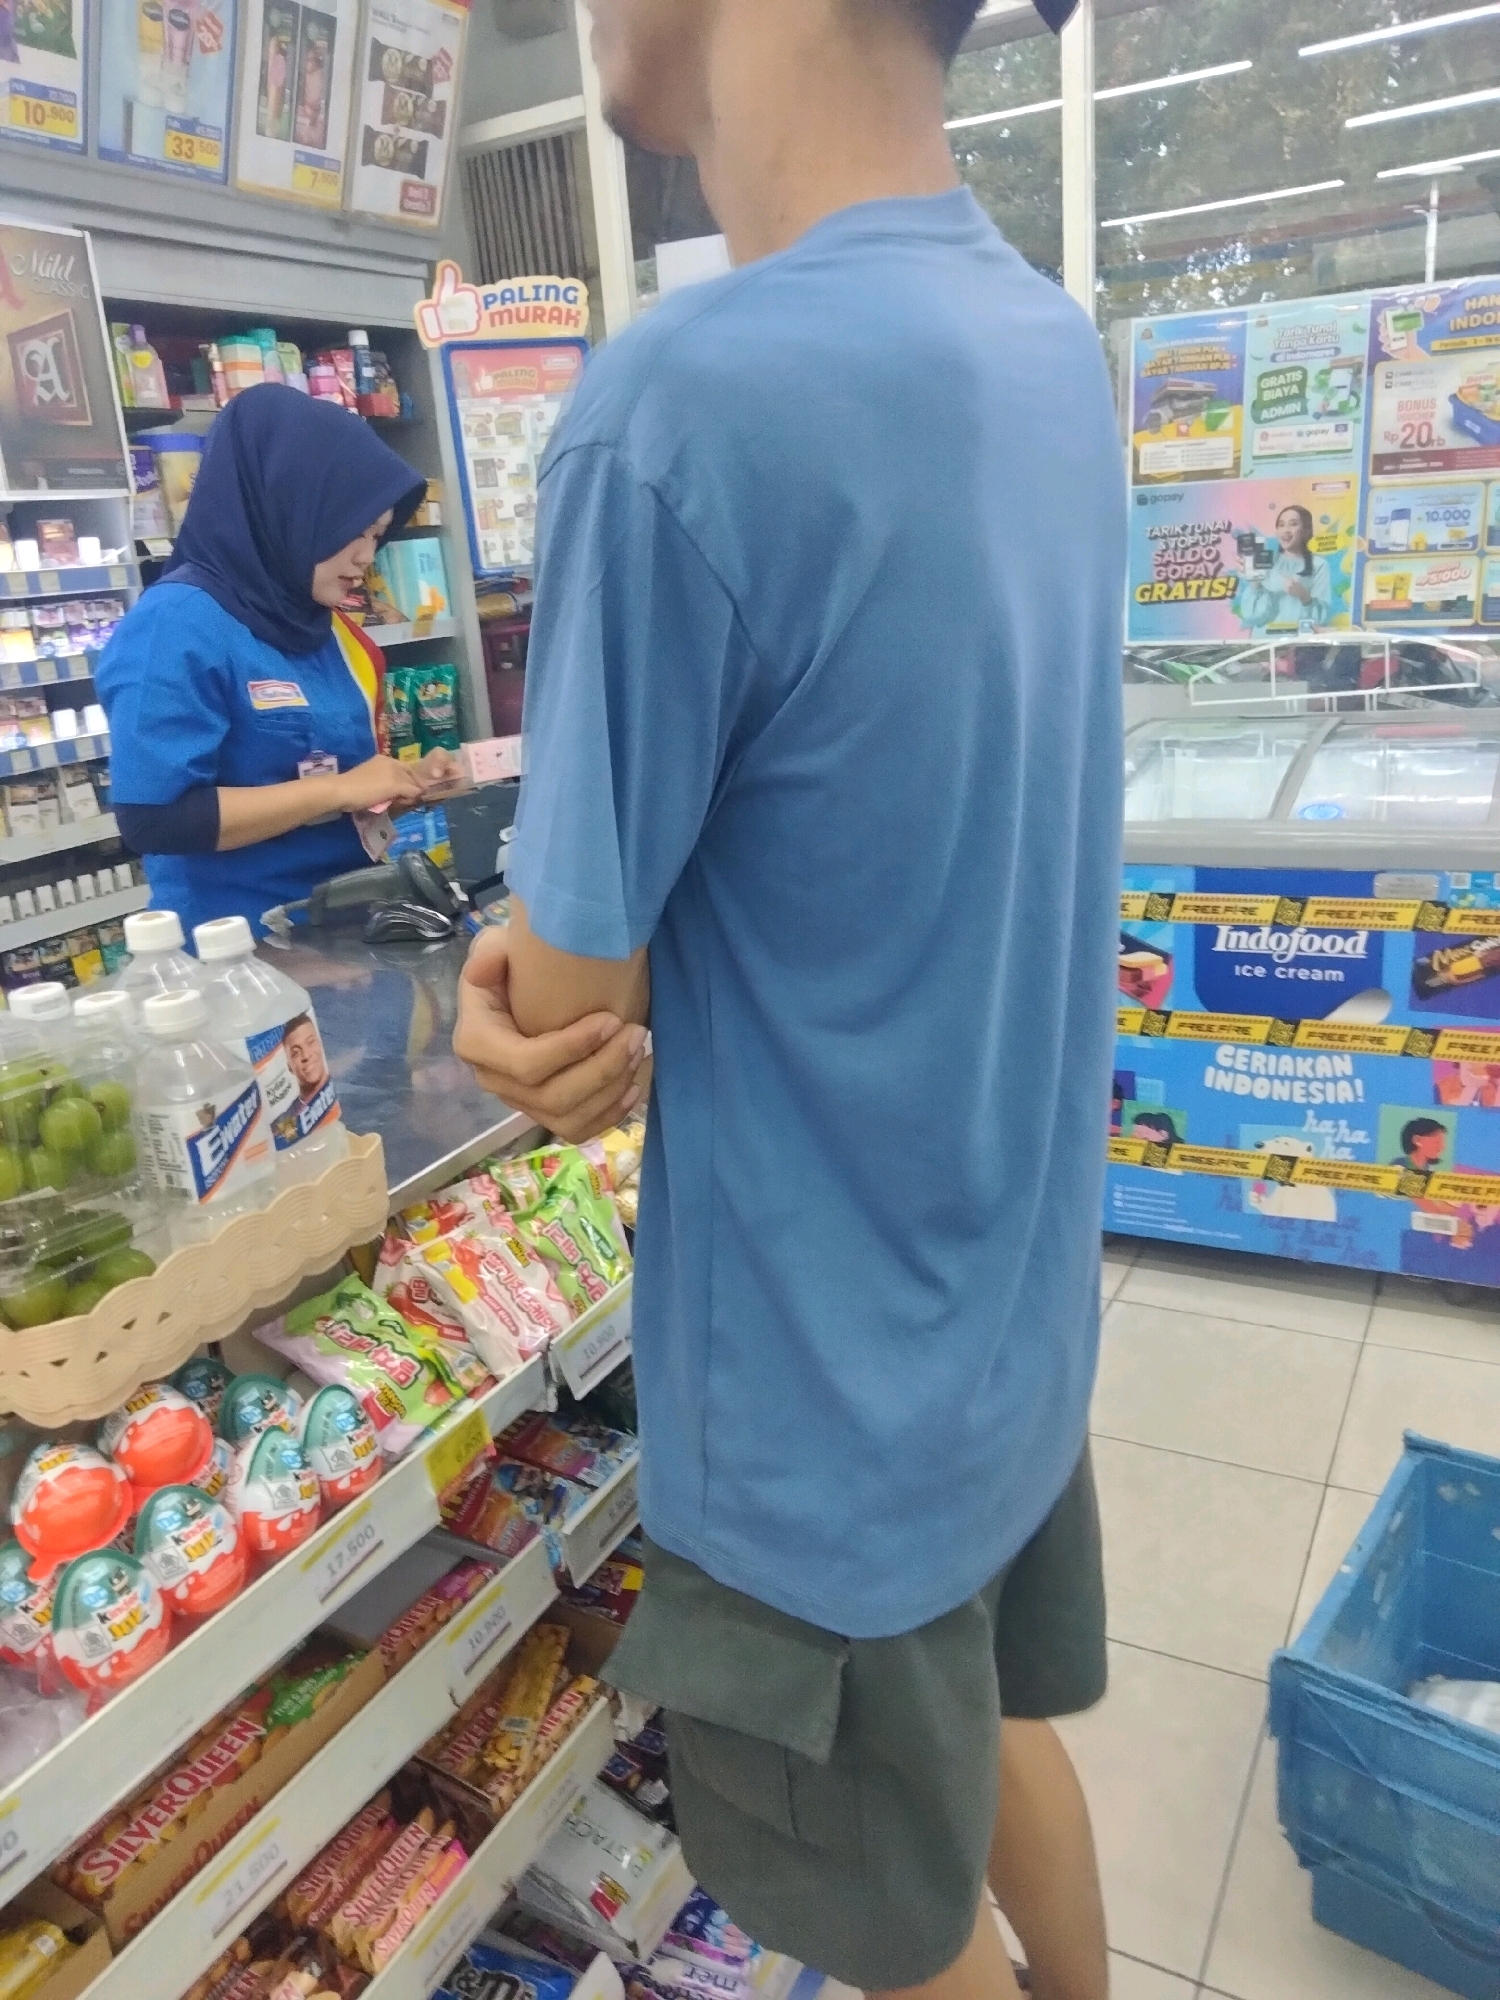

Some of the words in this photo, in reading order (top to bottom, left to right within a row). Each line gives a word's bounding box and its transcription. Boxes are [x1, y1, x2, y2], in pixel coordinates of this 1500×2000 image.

[32, 277, 91, 299] CLASSIC
[482, 284, 580, 311] PALING
[1449, 311, 1500, 333] INDO
[1260, 370, 1303, 389] GRATIS
[1262, 385, 1299, 401] BIAYA
[1261, 402, 1301, 421] ADMIN
[1397, 398, 1437, 412] BONUS
[1145, 525, 1182, 540] TARIK
[1185, 520, 1231, 535] TUNAI
[1153, 546, 1220, 565] SALDO
[1155, 562, 1224, 580] GOPAY
[1135, 577, 1238, 604] GRATIS!
[1213, 924, 1368, 964] Indofood
[1274, 966, 1346, 982] cream
[1216, 1044, 1354, 1079] CERIAKAN
[1204, 1065, 1365, 1105] INDONESIA!
[1302, 1109, 1338, 1134] ha
[1334, 1119, 1371, 1144] ha
[1320, 1136, 1356, 1161] ha
[76, 1717, 267, 1888] SILVERQUEEN
